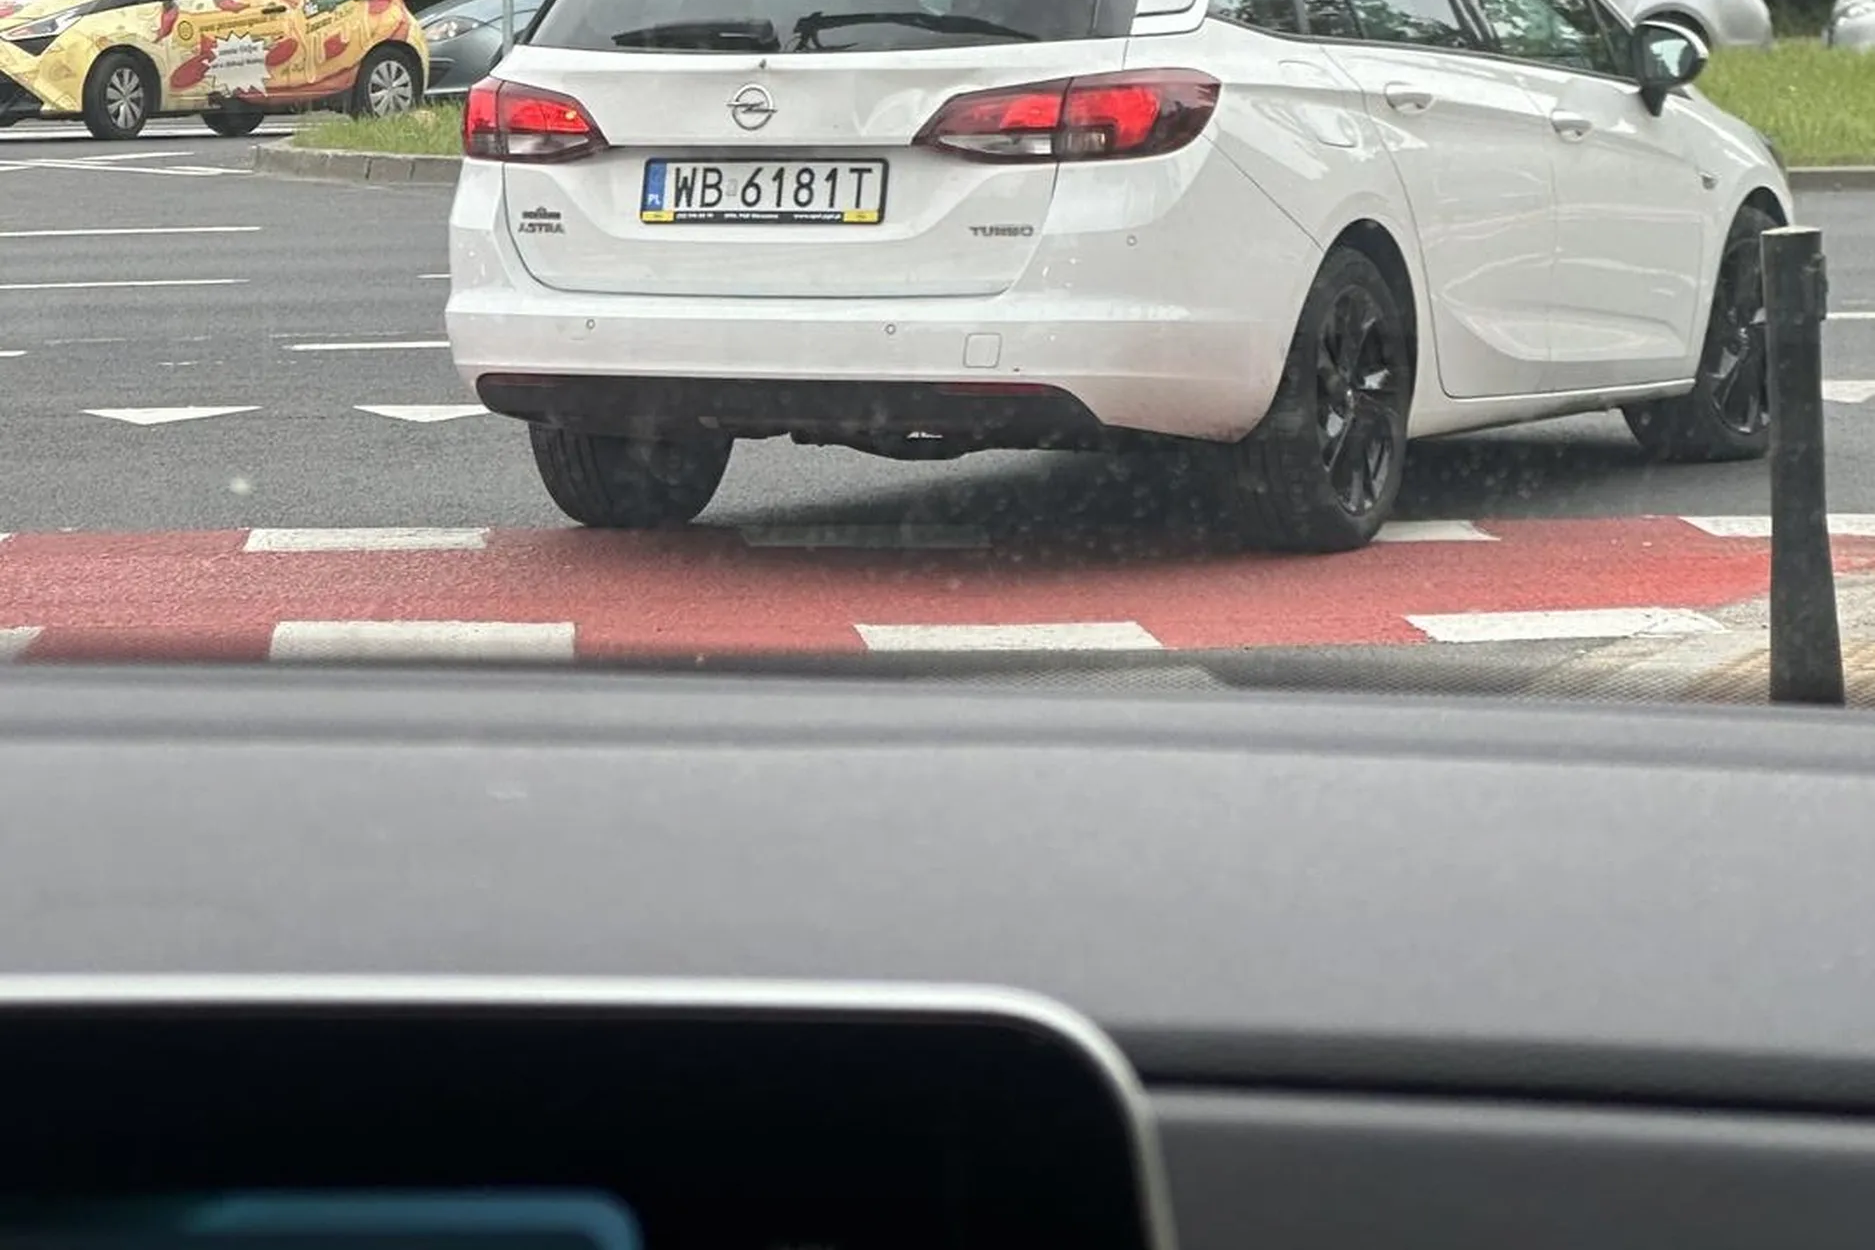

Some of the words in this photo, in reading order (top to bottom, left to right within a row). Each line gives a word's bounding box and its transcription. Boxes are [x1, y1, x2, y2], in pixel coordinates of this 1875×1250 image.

[674, 166, 723, 209] WB
[740, 166, 873, 209] 6181T
[648, 193, 661, 206] PL
[517, 222, 566, 234] ASTRA
[968, 224, 1034, 237] TURBO
